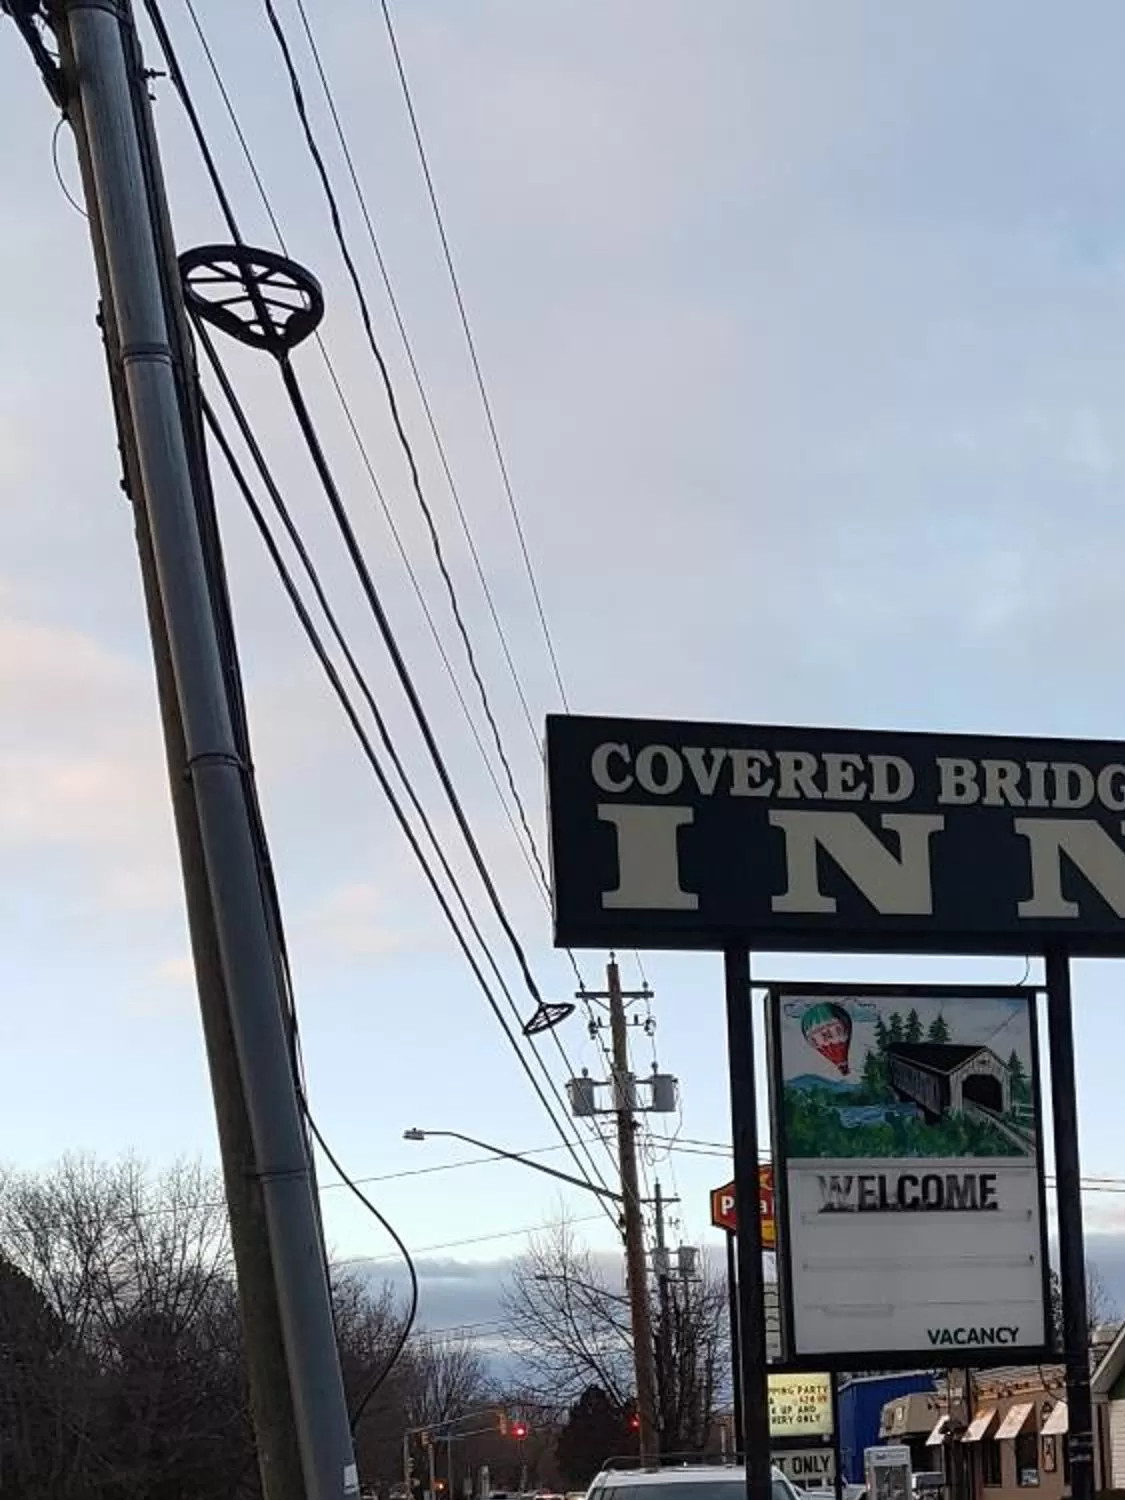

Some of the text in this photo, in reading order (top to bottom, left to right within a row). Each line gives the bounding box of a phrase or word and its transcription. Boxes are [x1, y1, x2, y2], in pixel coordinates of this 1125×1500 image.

[591, 742, 915, 802] COVERED
[817, 1174, 998, 1213] WELCOME
[926, 1326, 1020, 1346] VACANCY
[792, 1456, 830, 1473] ONLY
